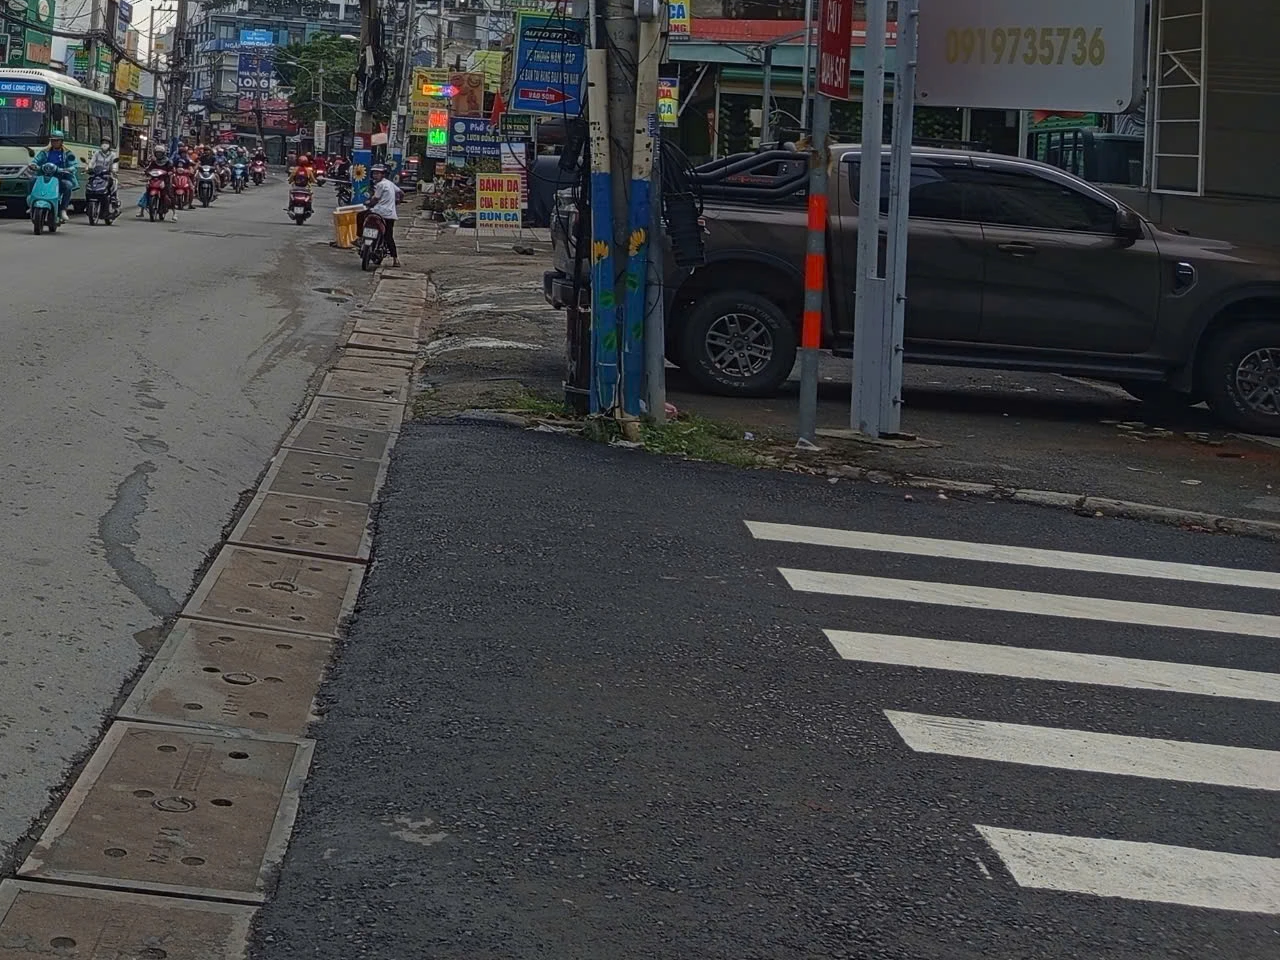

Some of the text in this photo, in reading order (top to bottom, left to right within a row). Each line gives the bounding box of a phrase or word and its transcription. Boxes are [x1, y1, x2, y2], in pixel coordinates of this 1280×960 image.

[524, 30, 550, 38] AUTO
[945, 26, 1106, 67] 0919735736
[239, 78, 269, 88] LONG
[240, 91, 268, 100] CHU
[480, 177, 503, 192] BÁNH
[480, 196, 494, 209] CUA
[480, 210, 502, 221] BÚN
